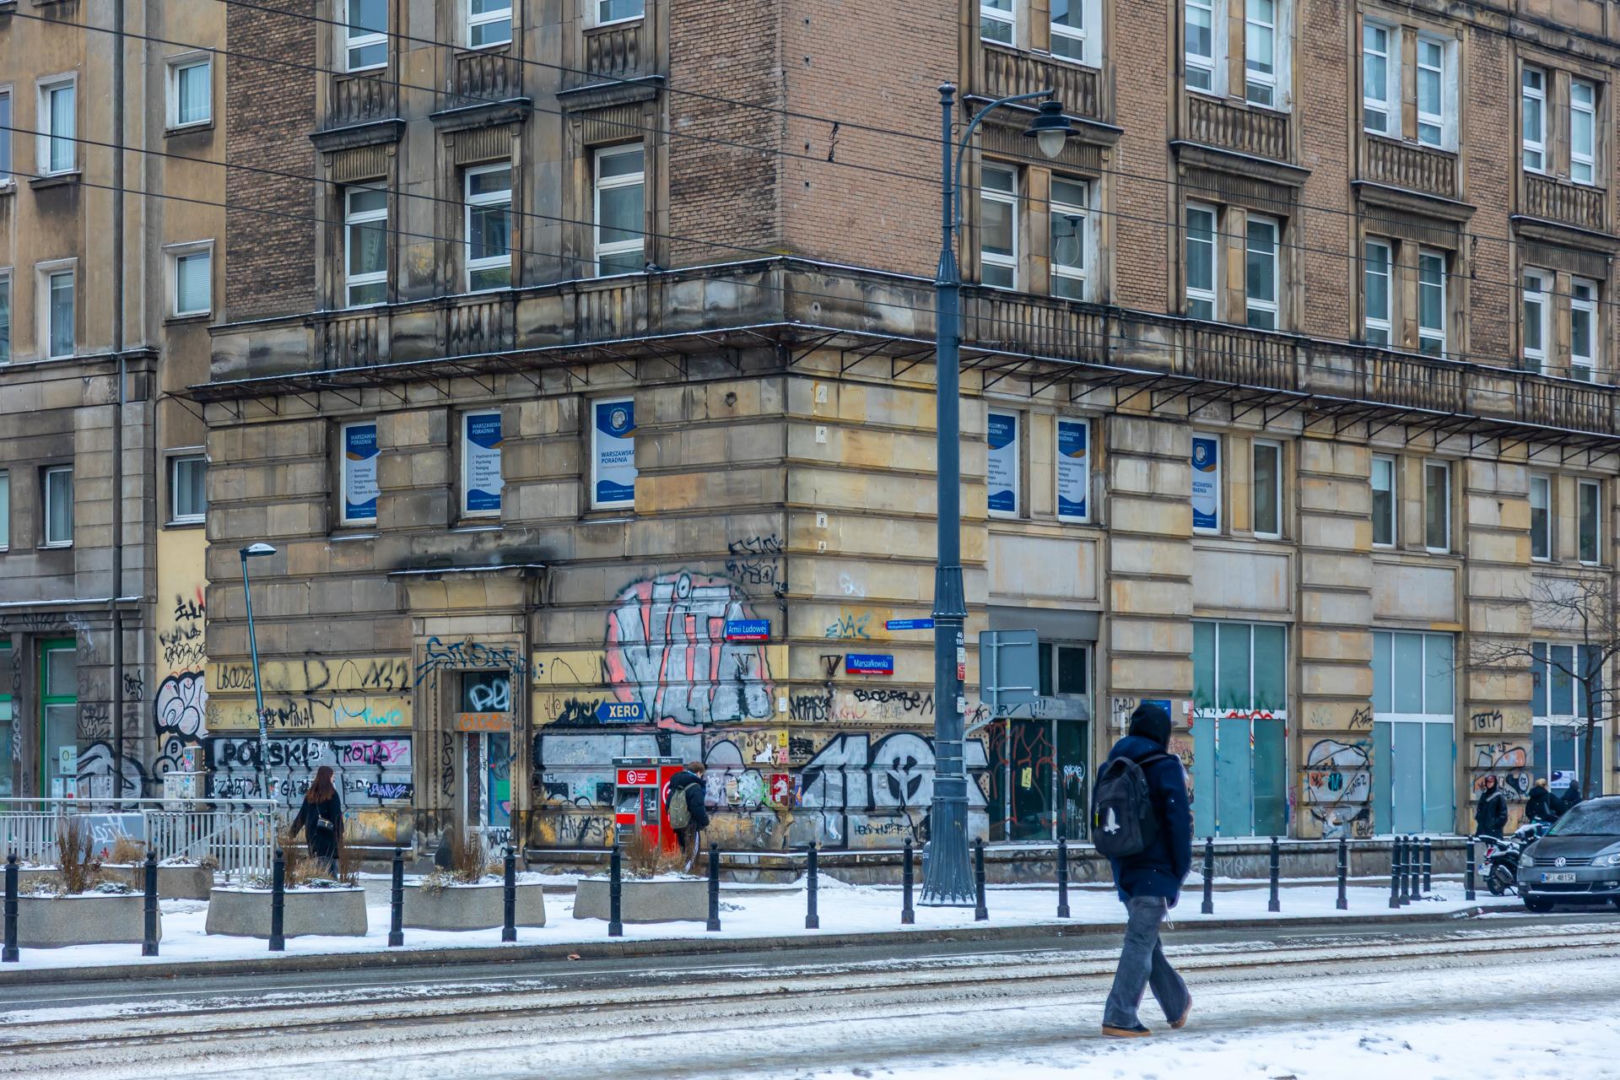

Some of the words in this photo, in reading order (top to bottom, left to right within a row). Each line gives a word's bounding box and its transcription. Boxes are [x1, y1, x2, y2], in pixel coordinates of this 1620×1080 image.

[601, 456, 628, 464] PORADNIA
[728, 625, 742, 633] Armii
[742, 624, 767, 635] Ludowej
[609, 704, 640, 718] XERO
